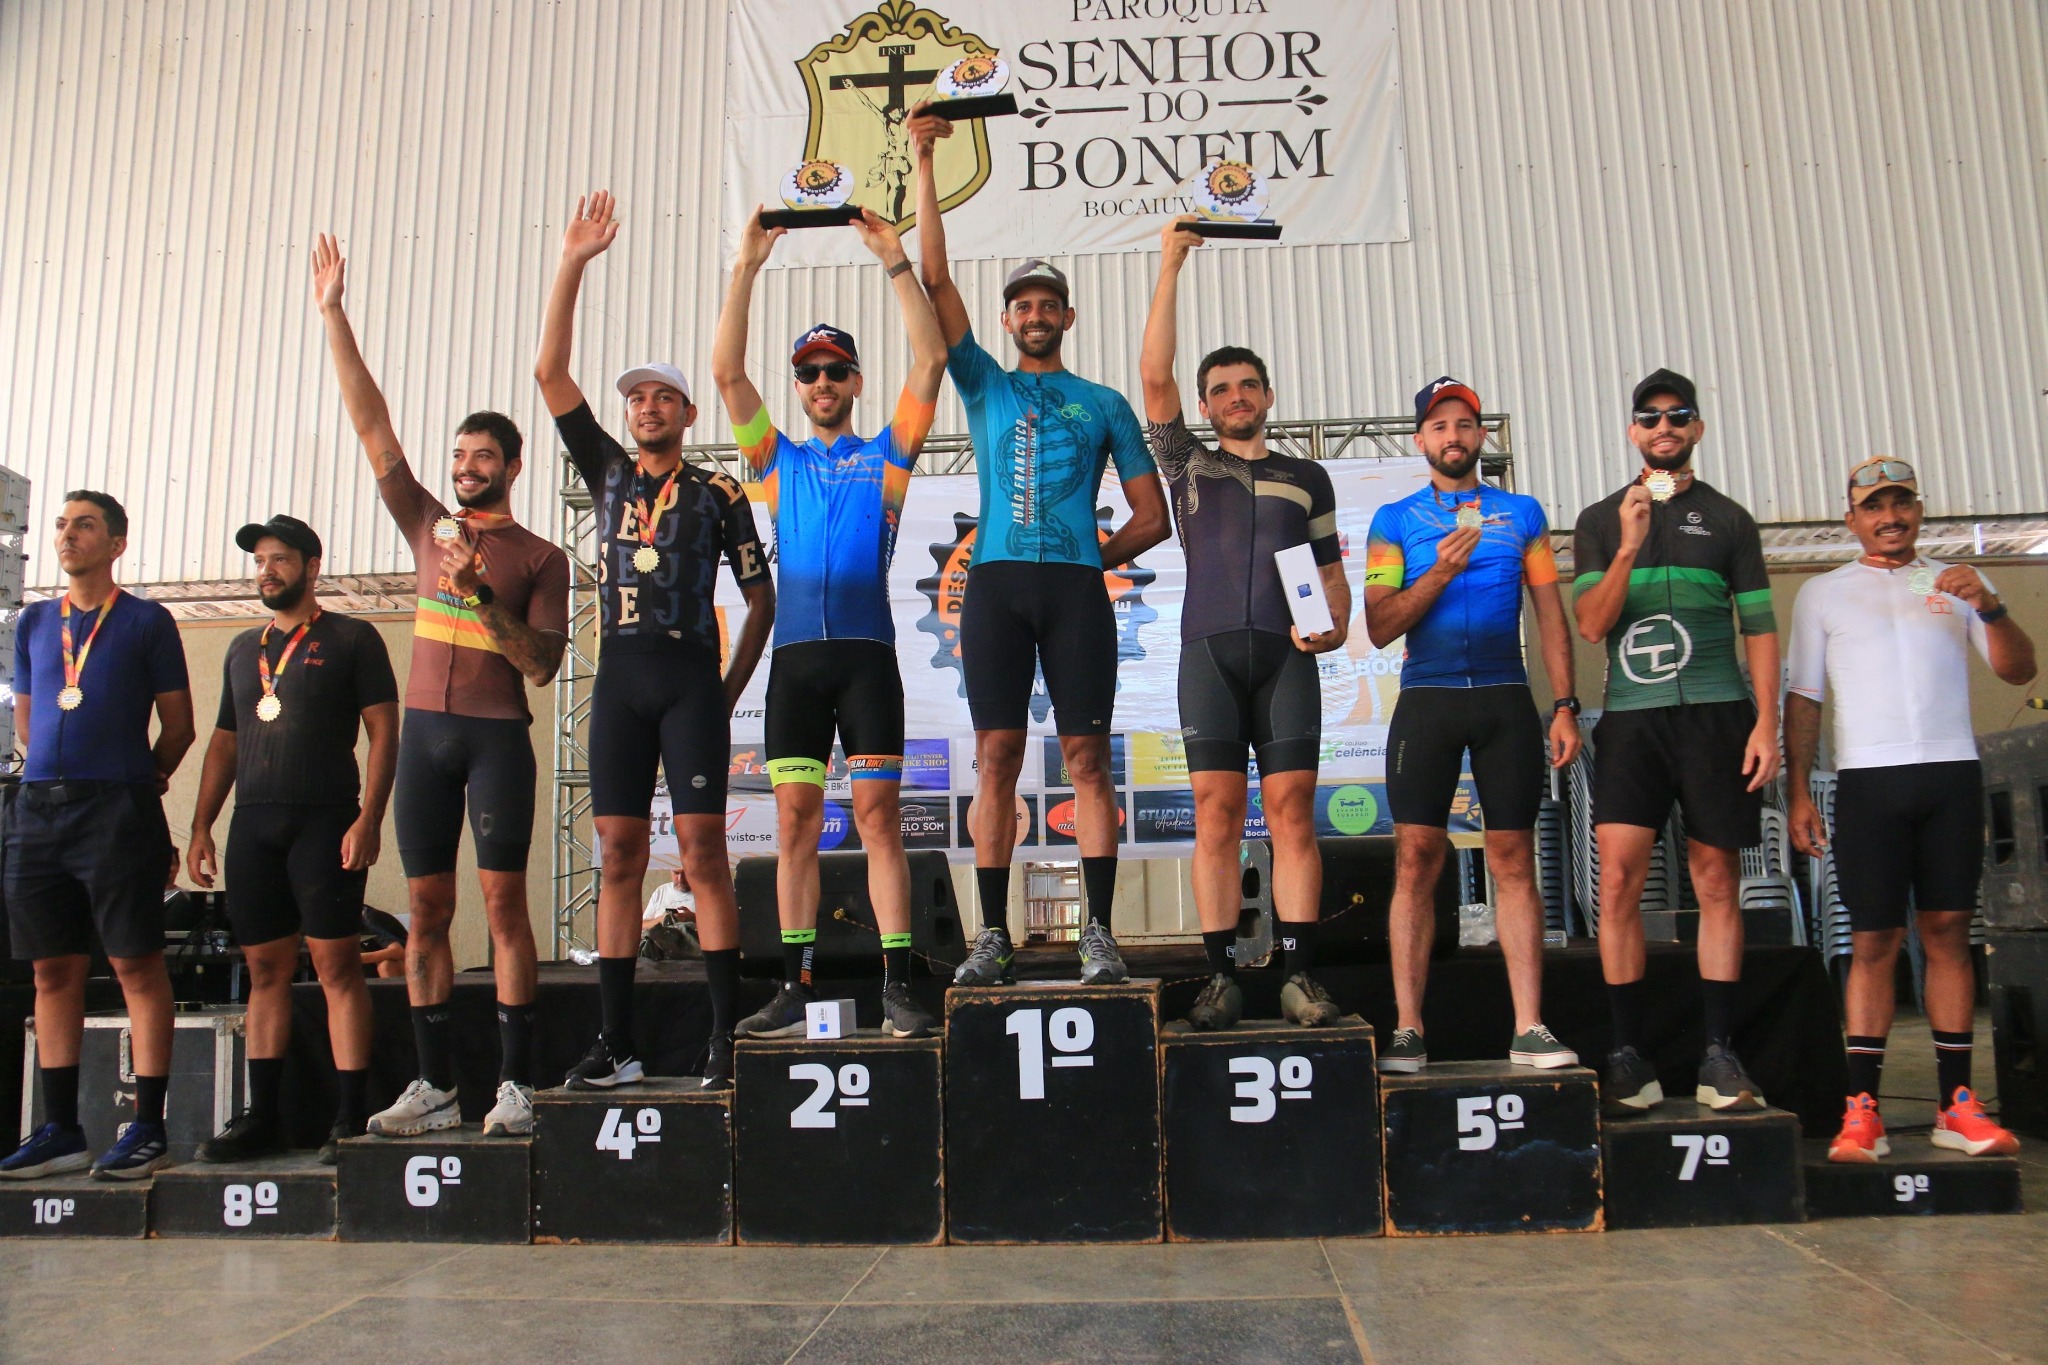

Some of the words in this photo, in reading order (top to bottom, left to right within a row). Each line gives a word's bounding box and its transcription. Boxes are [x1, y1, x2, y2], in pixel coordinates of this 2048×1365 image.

[882, 46, 912, 55] INRI
[1018, 31, 1327, 94] SENHOR
[1139, 89, 1209, 123] DO
[1018, 128, 1334, 191] BONFIM
[1083, 196, 1198, 217] BOCAIUV
[1014, 418, 1028, 489] FRANCISCO
[1029, 427, 1038, 477] ESPECIALIZADA
[1012, 494, 1025, 524] JOÃO
[1028, 481, 1036, 524] ASSESSORIA
[866, 759, 885, 768] BIKE
[923, 759, 948, 767] SHOP
[831, 782, 850, 791] BIKE
[1138, 807, 1191, 821] STUDIO
[901, 822, 920, 832] ELO
[923, 822, 944, 831] SOM
